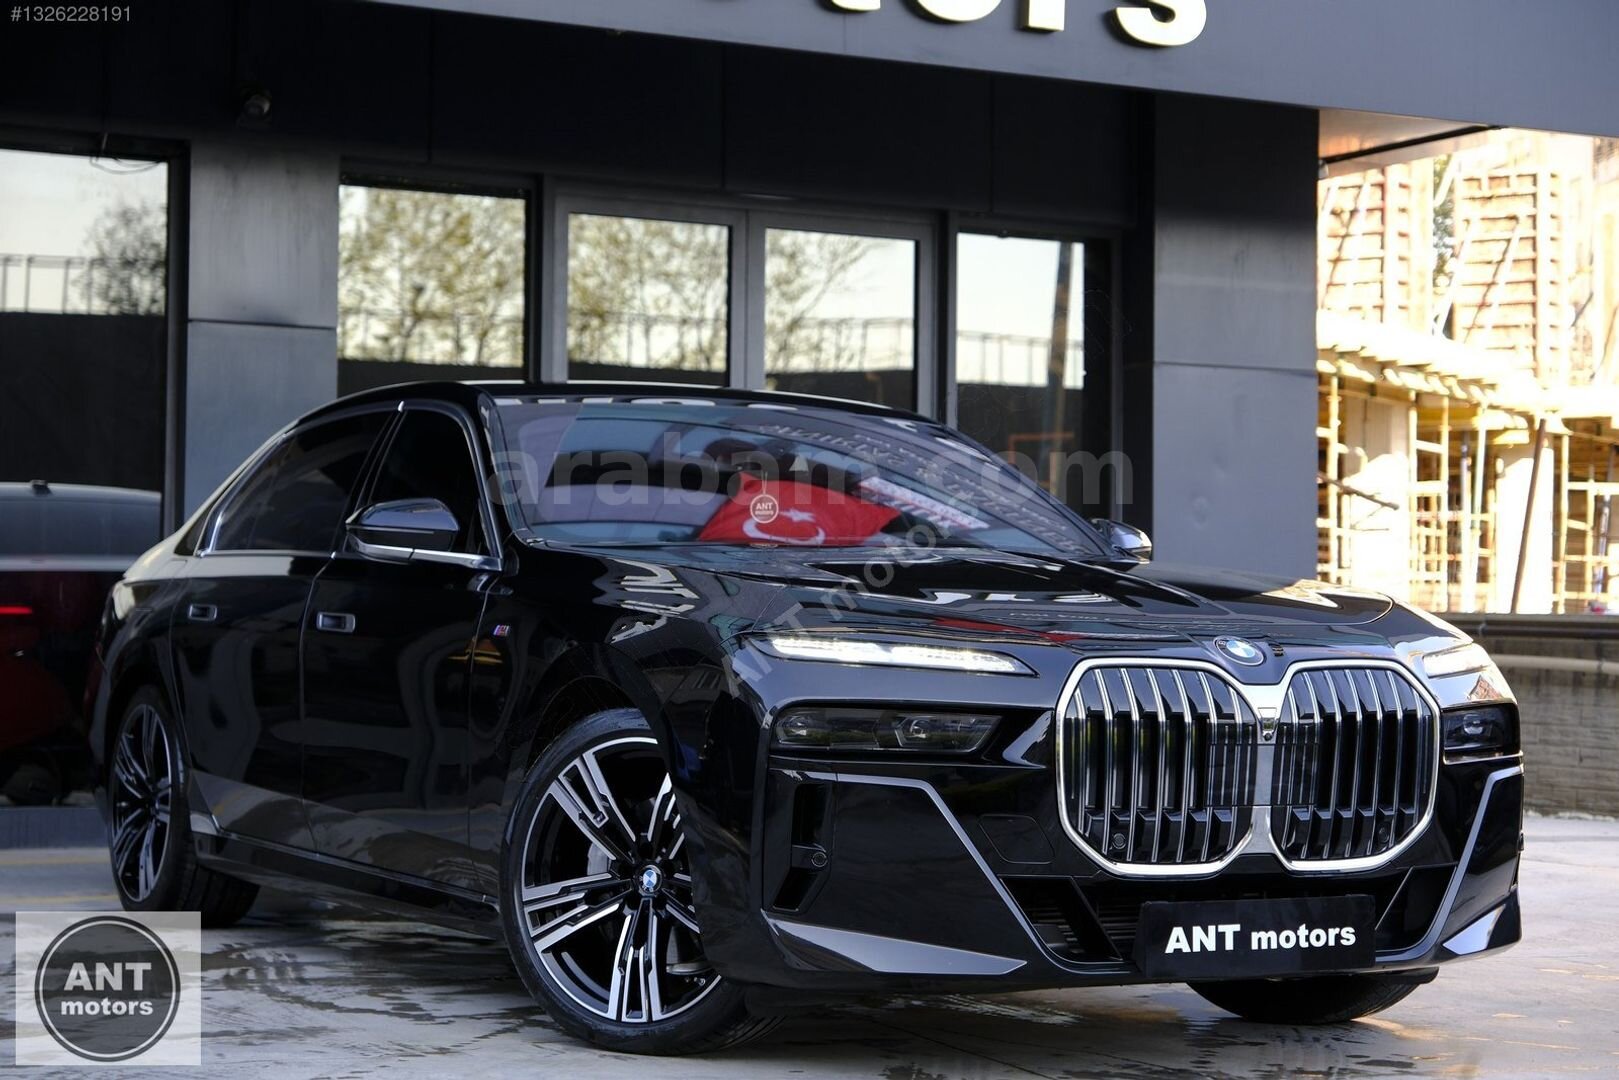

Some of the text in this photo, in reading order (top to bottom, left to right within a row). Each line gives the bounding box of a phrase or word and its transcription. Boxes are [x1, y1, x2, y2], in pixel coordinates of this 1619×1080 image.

[755, 502, 773, 510] ANT
[1164, 923, 1357, 954] ANT motors
